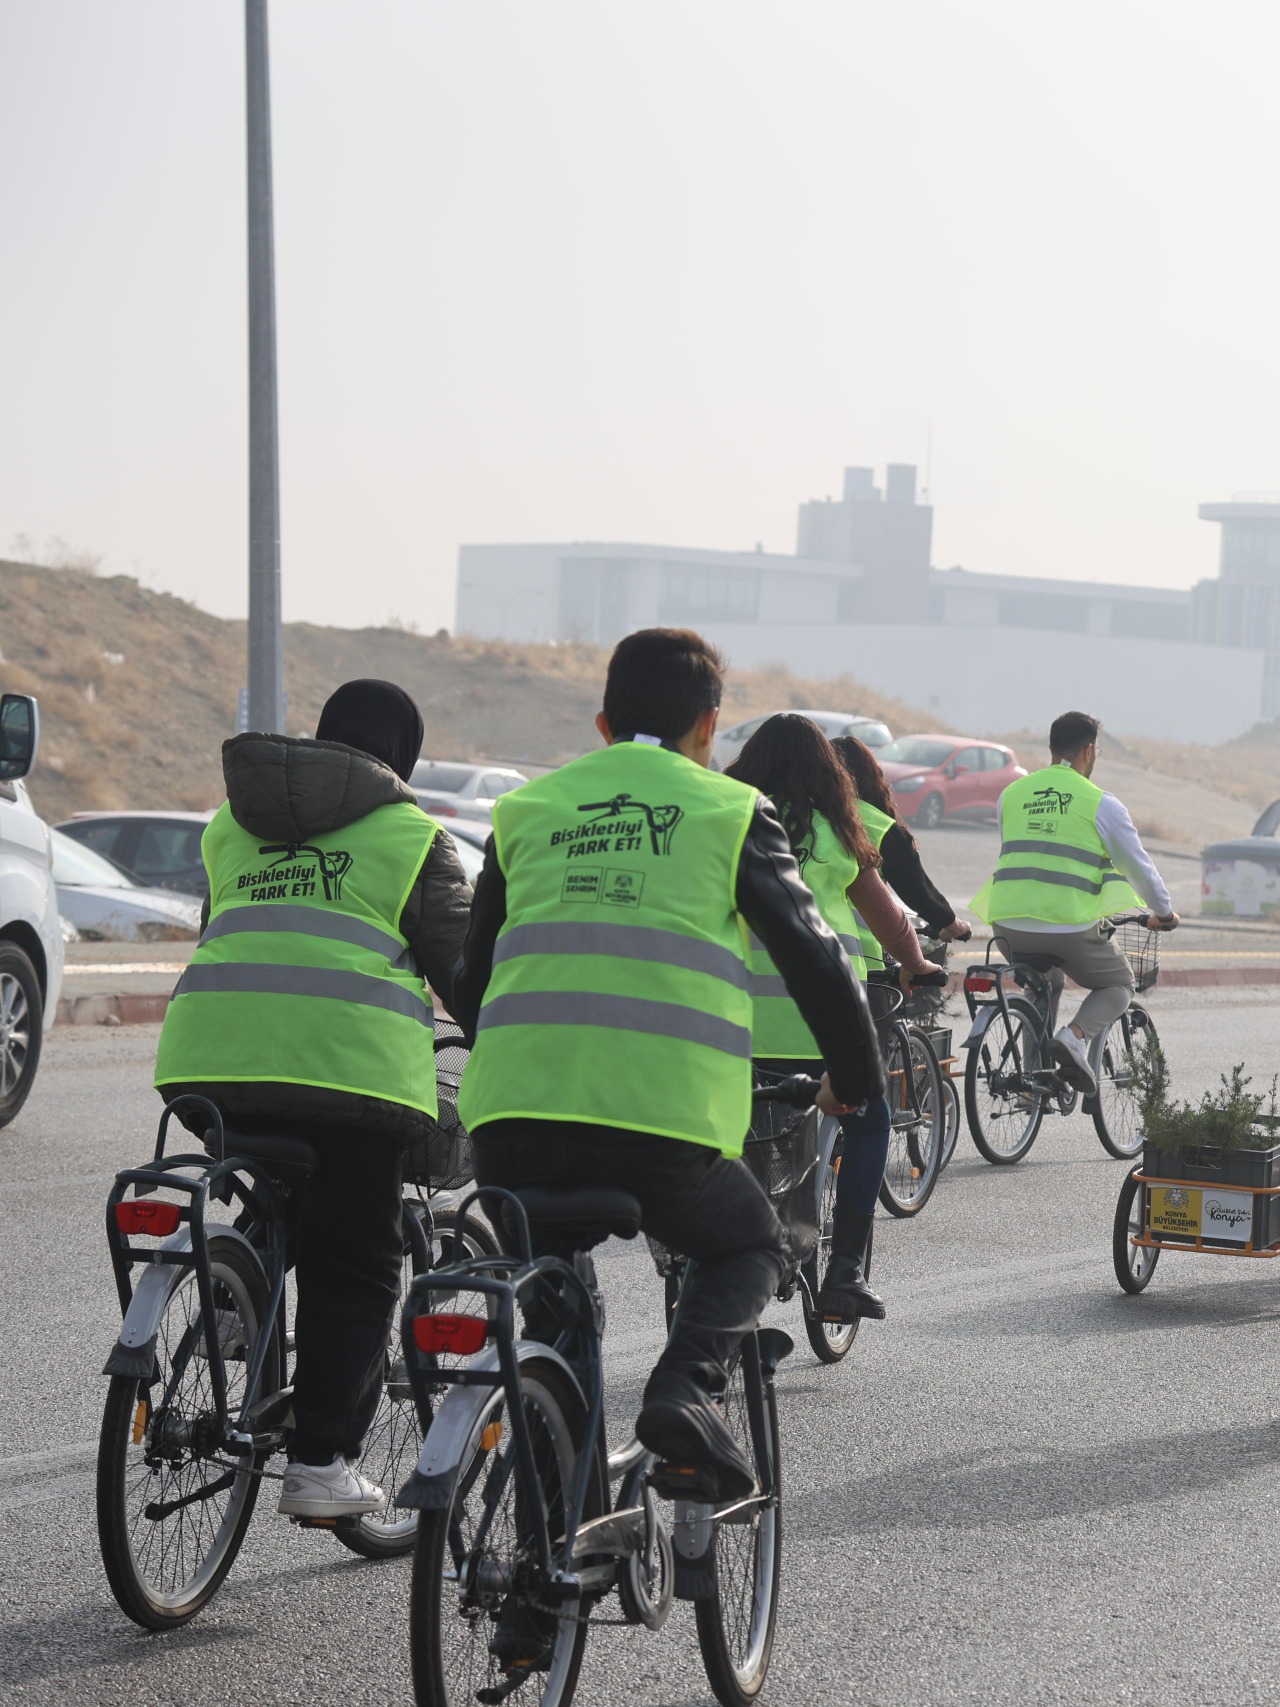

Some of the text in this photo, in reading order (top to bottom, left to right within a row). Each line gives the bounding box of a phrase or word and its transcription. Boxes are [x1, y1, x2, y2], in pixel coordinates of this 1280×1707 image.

[1028, 807, 1045, 815] FARK
[550, 820, 643, 846] Bisikletliyi
[566, 836, 642, 859] FARK ET!
[237, 864, 317, 890] Bisikletliyi
[250, 882, 316, 902] FARK ET!
[1165, 1210, 1187, 1219] KONYA
[1210, 1207, 1245, 1228] Konya
